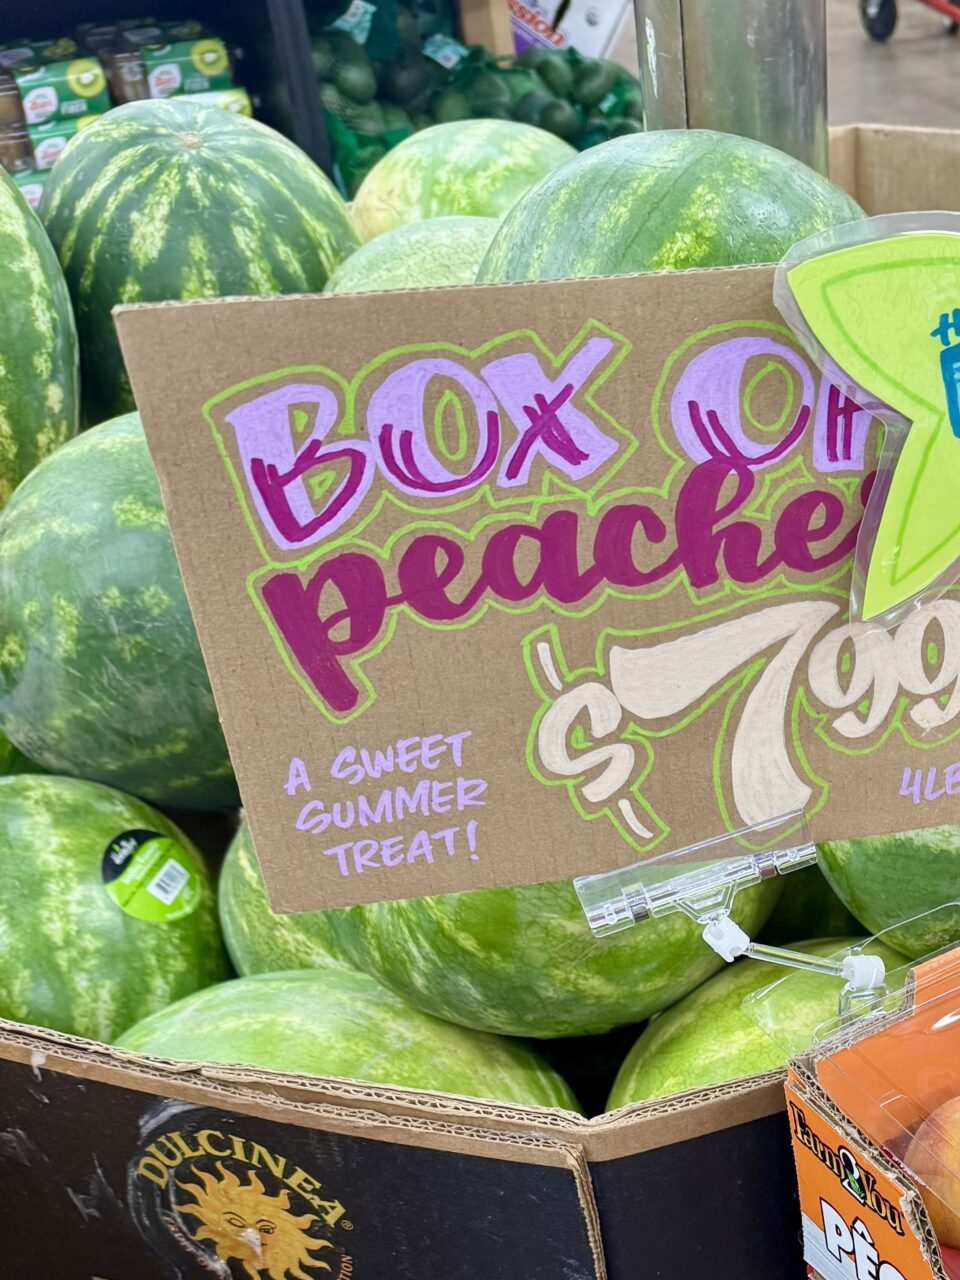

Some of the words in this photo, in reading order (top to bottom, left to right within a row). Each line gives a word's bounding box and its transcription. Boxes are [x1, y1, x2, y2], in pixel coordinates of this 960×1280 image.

[225, 337, 619, 551] BOX
[284, 757, 310, 796] A
[331, 730, 472, 785] SWEET
[296, 776, 488, 834] SUMMER
[323, 821, 480, 877] TREAT!
